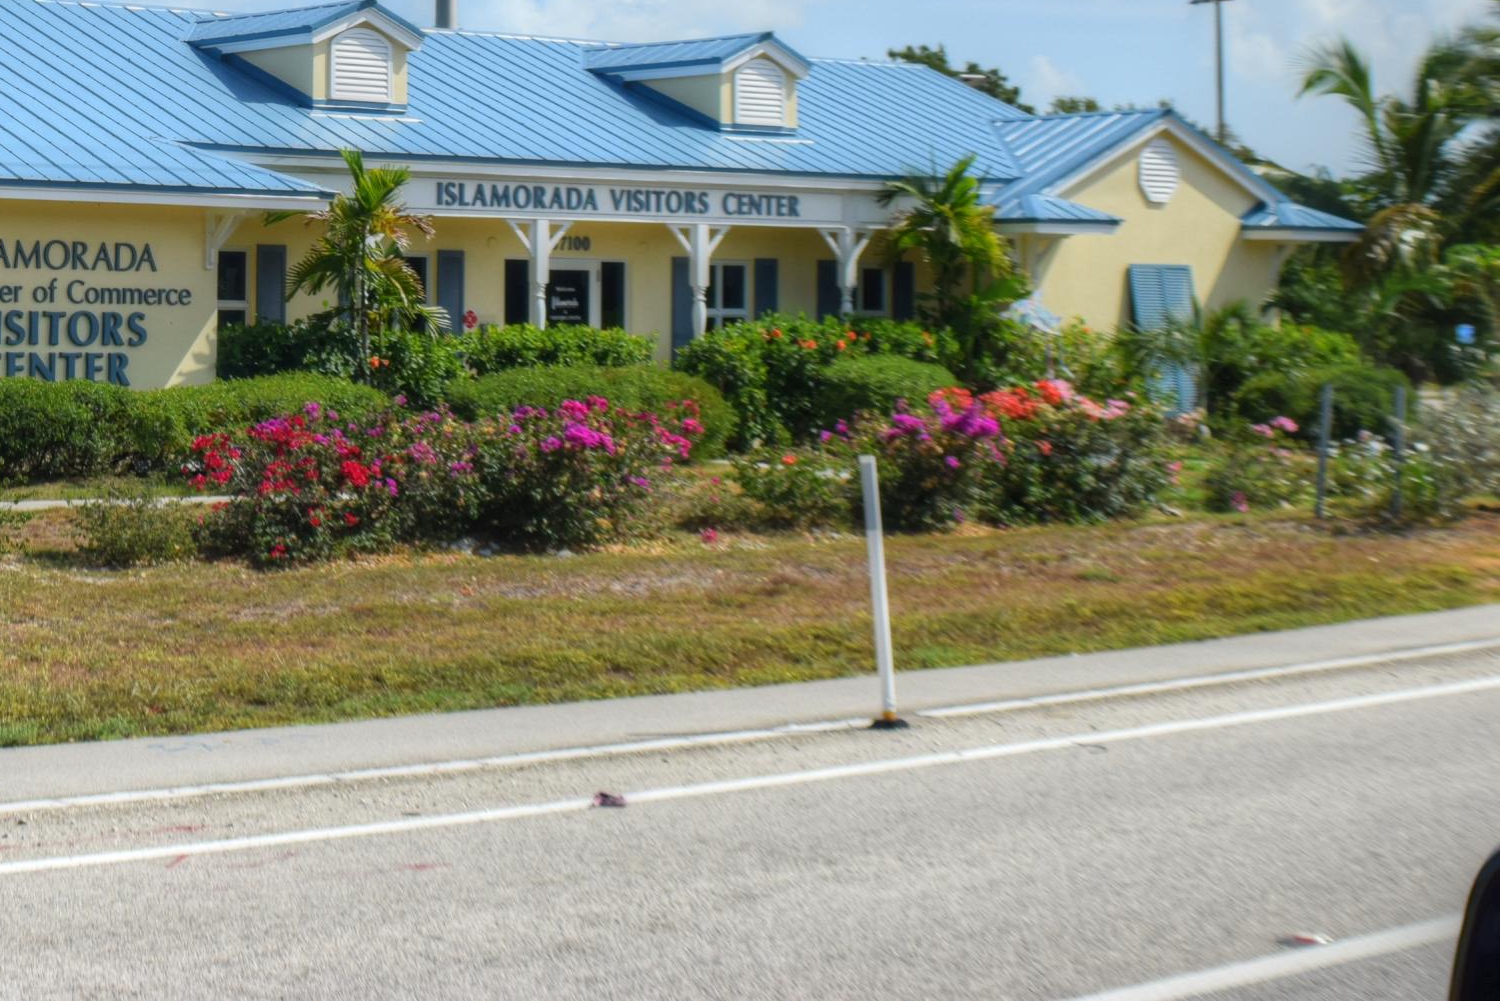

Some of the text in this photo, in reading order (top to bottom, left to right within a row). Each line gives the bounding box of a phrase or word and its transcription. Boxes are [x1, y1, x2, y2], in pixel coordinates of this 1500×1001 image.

[436, 182, 800, 217] ISLAMORADA VISITORS CENTER
[33, 278, 57, 304] of
[67, 280, 192, 306] Commerce
